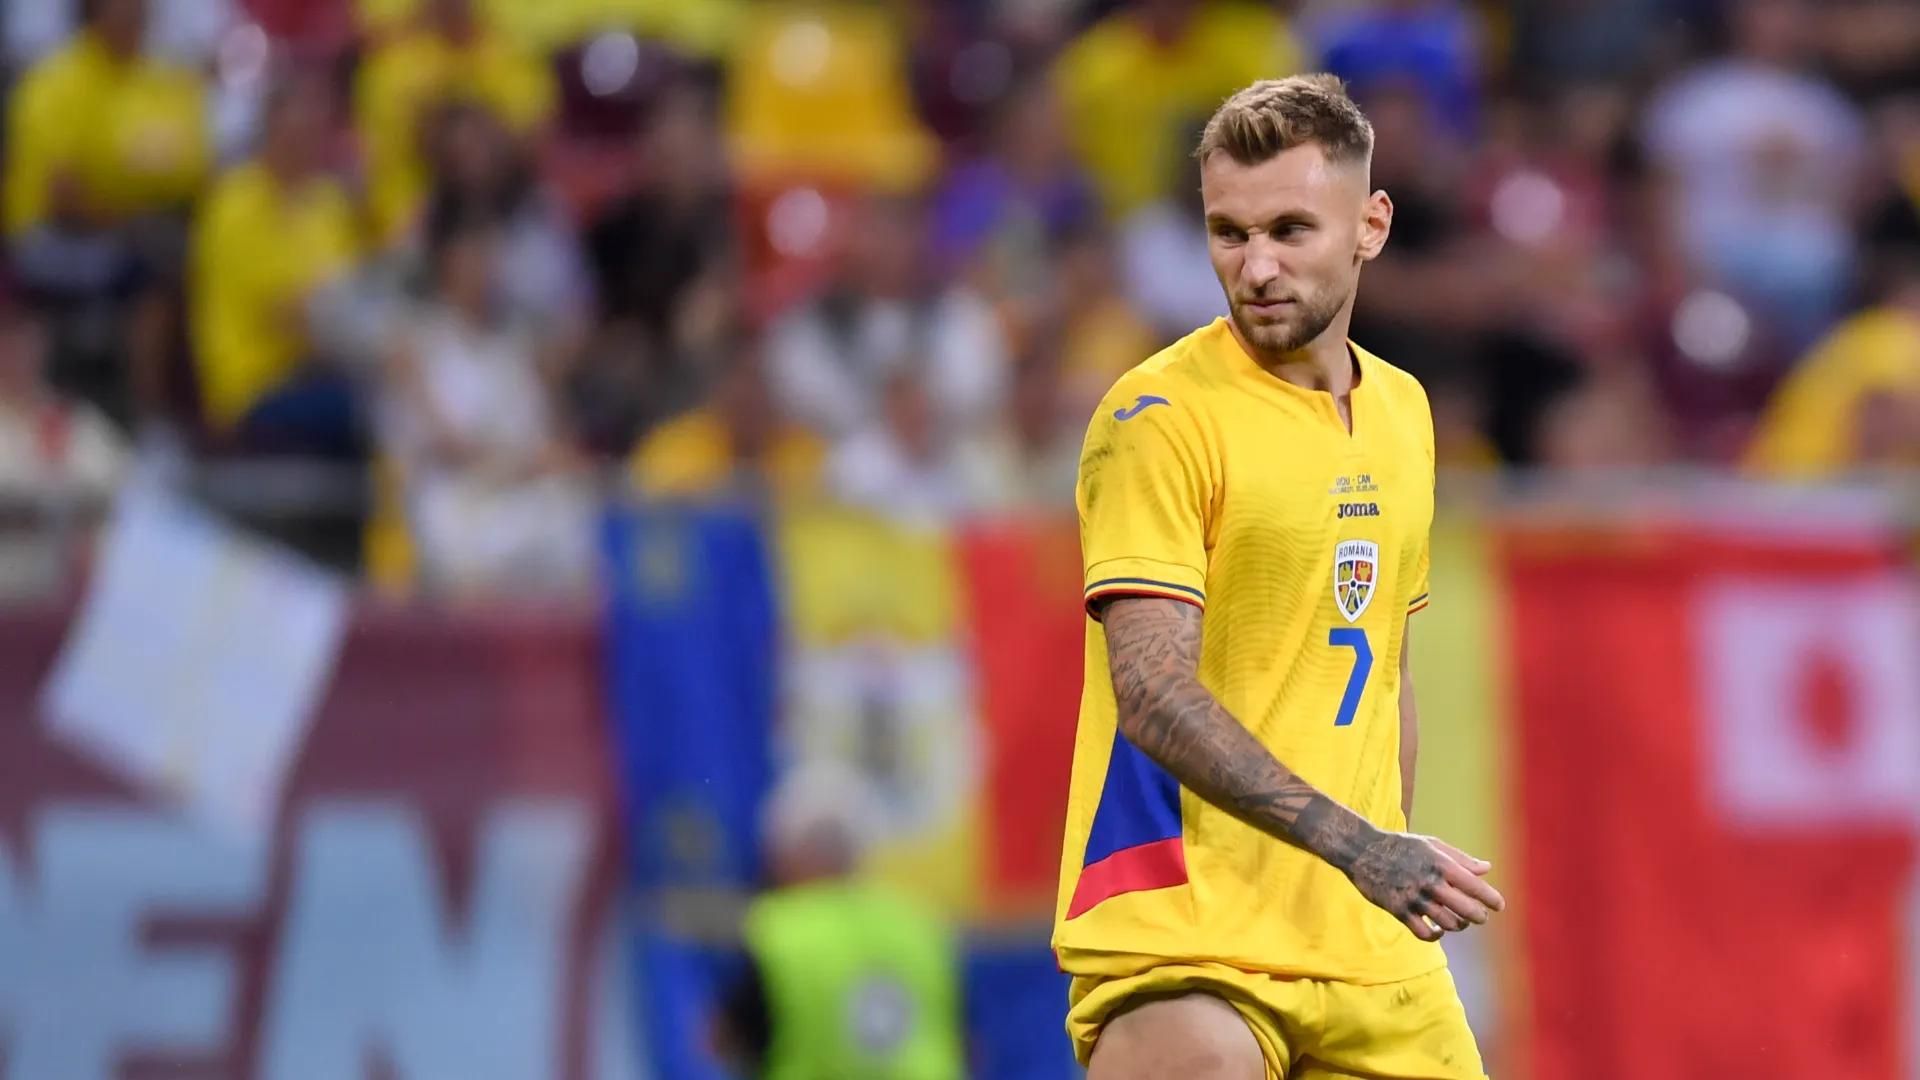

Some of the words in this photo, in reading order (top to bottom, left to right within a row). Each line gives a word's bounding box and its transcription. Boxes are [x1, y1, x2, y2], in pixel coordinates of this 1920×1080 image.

[1357, 474, 1371, 484] CAN
[1339, 542, 1373, 558] ROMÂNIA
[1329, 628, 1374, 726] 7
